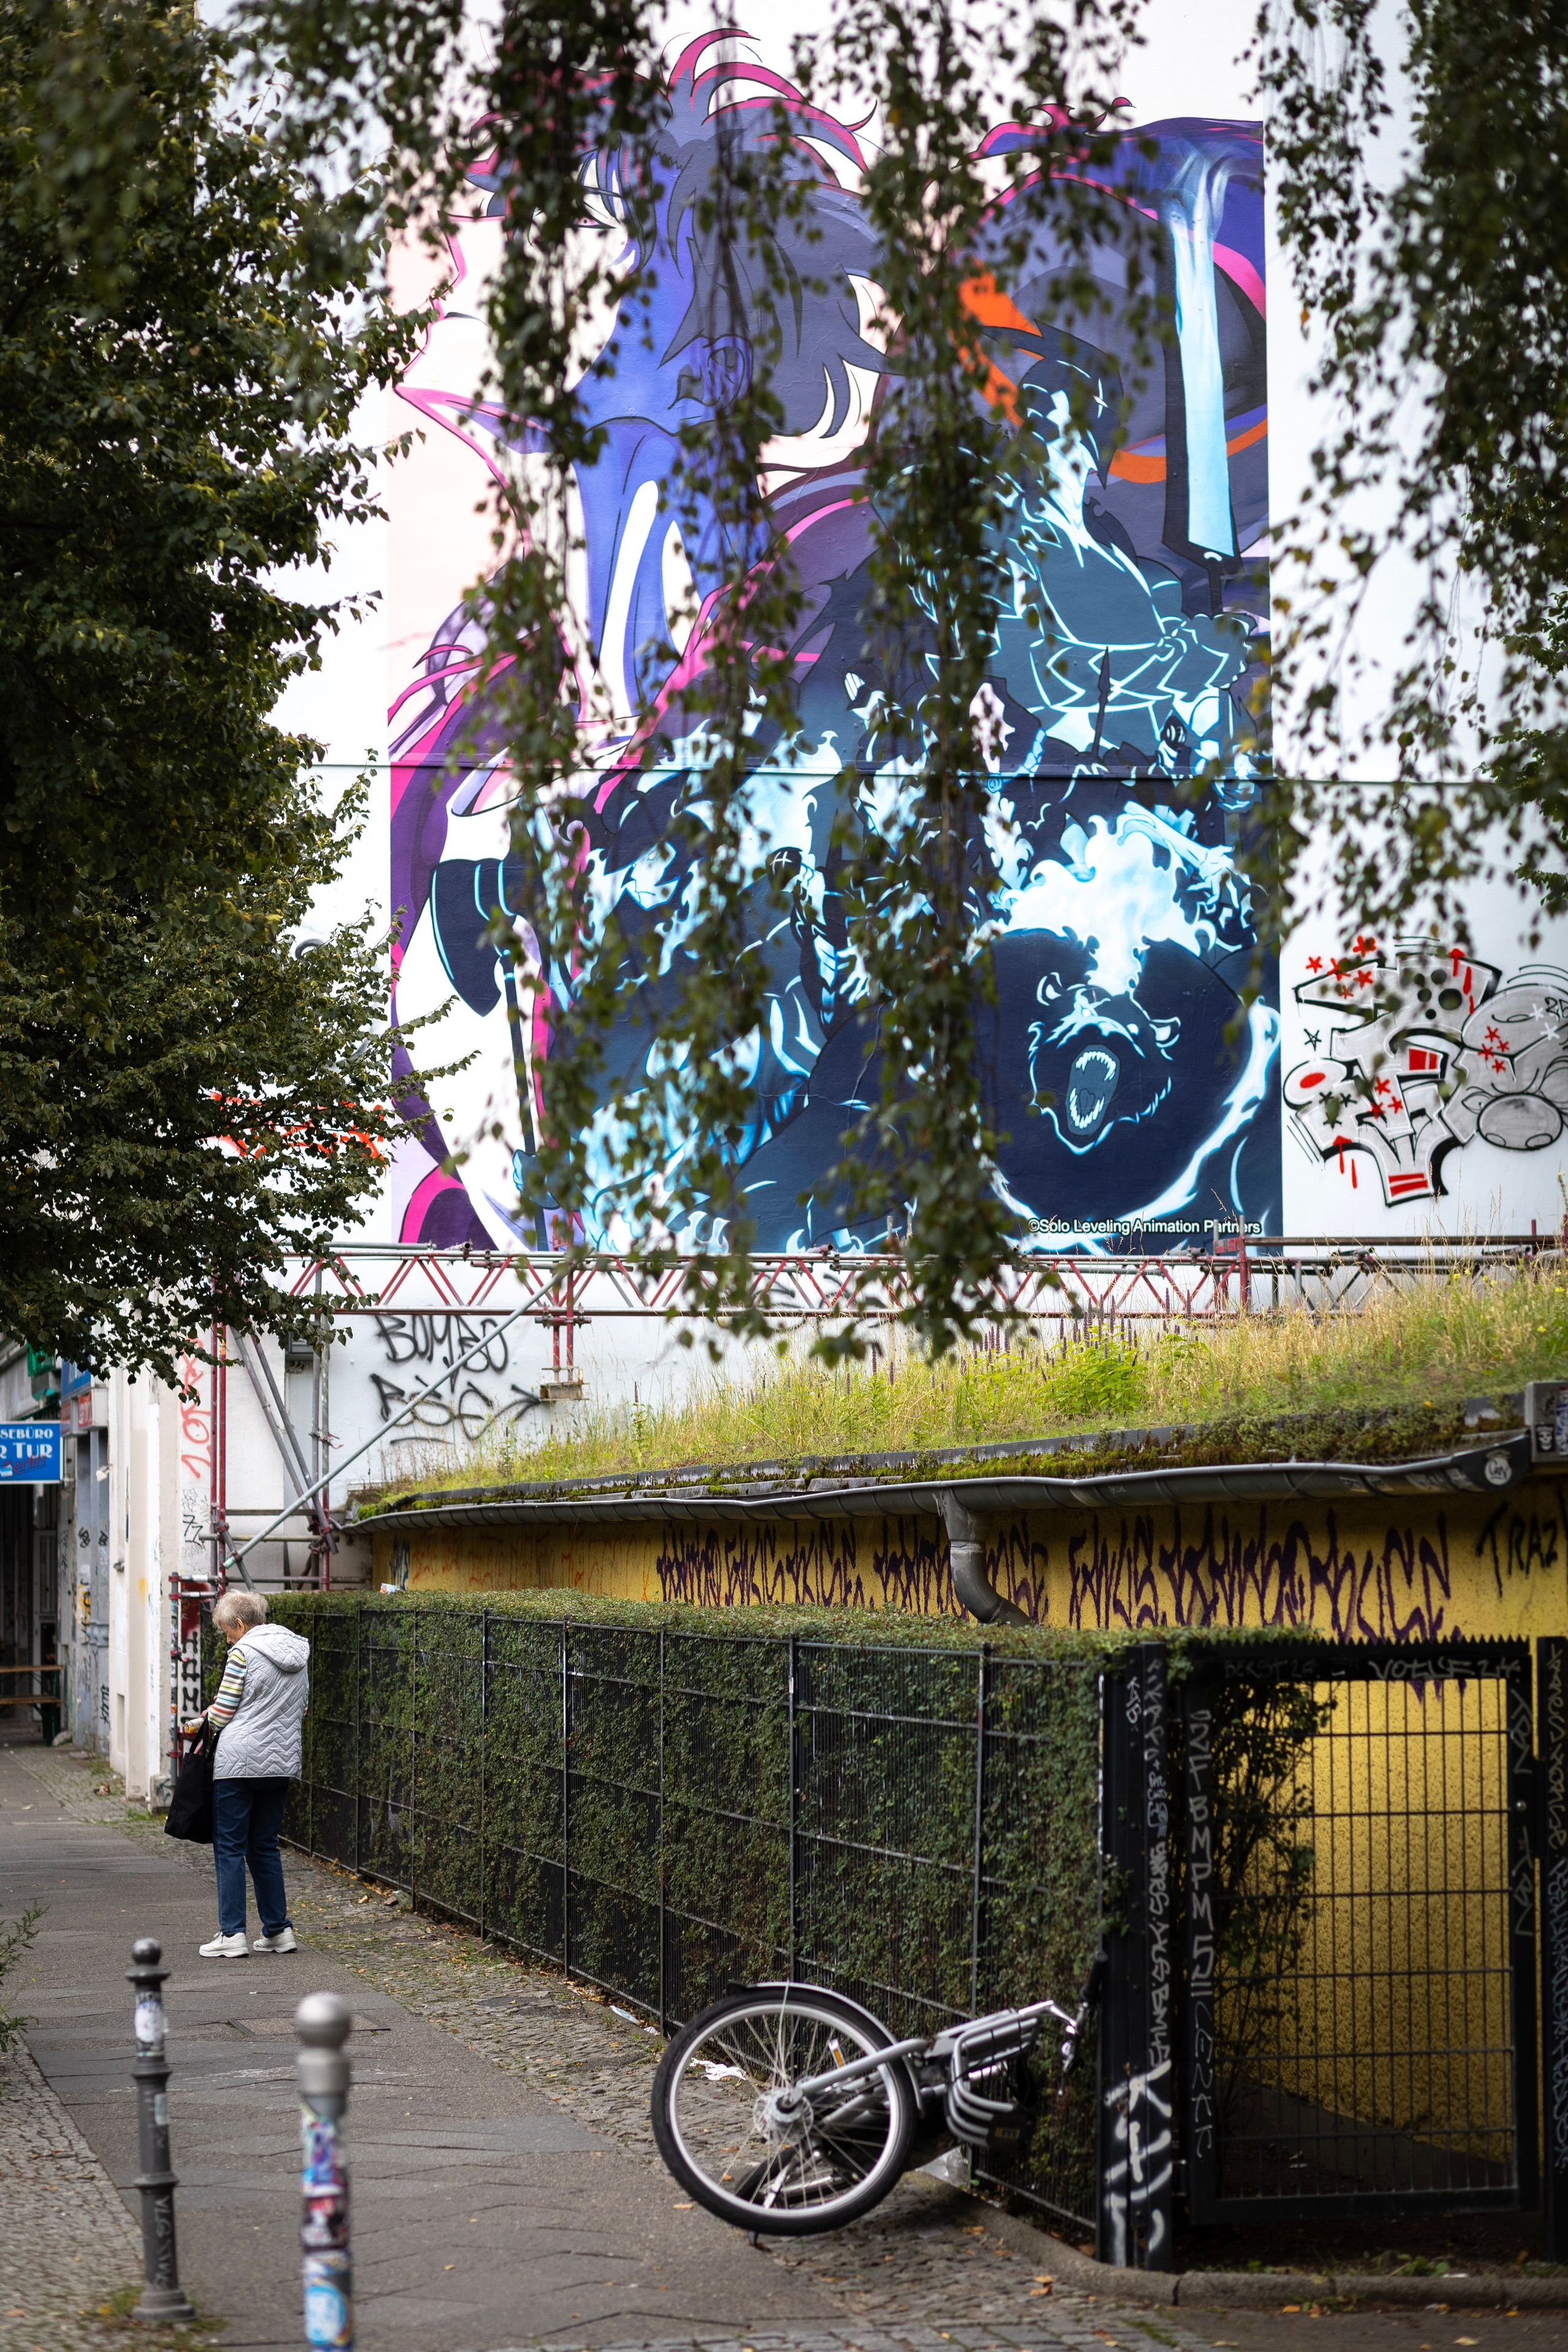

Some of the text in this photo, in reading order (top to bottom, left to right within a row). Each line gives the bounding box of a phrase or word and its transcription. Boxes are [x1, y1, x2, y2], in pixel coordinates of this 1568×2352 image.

[1074, 1218, 1130, 1235] Leveling
[1133, 1218, 1200, 1232] Animation
[13, 1442, 53, 1459] TUR
